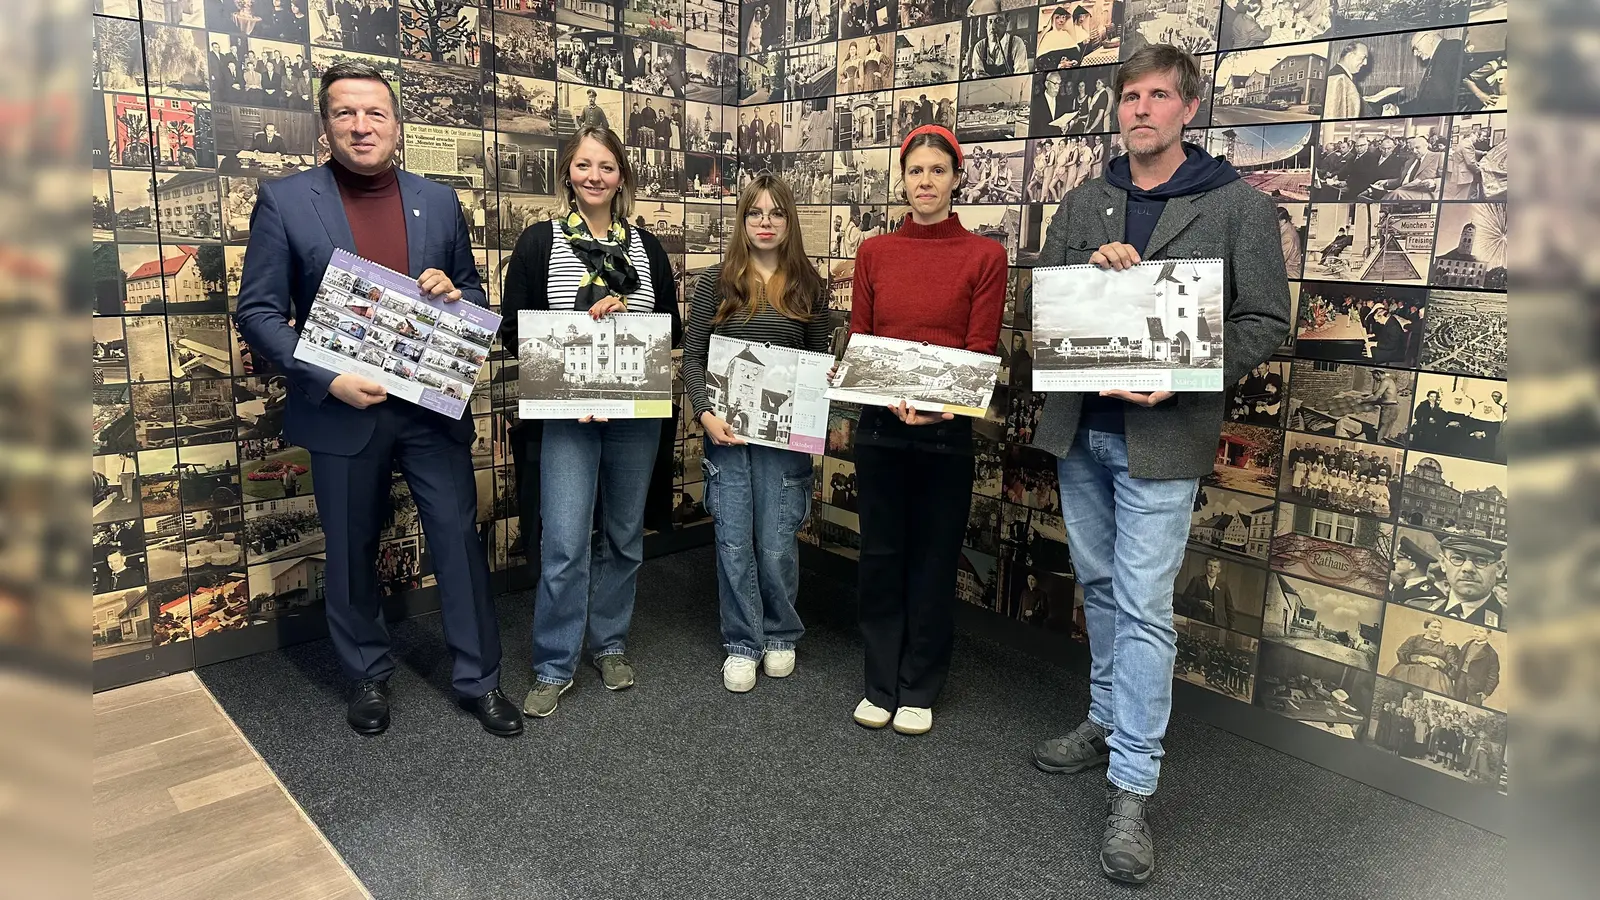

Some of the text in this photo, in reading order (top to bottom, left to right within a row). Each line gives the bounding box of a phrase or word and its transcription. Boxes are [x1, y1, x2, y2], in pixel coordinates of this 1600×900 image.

[1408, 236, 1433, 245] Freising
[791, 441, 814, 450] Oktober
[1310, 553, 1350, 571] Rathaus
